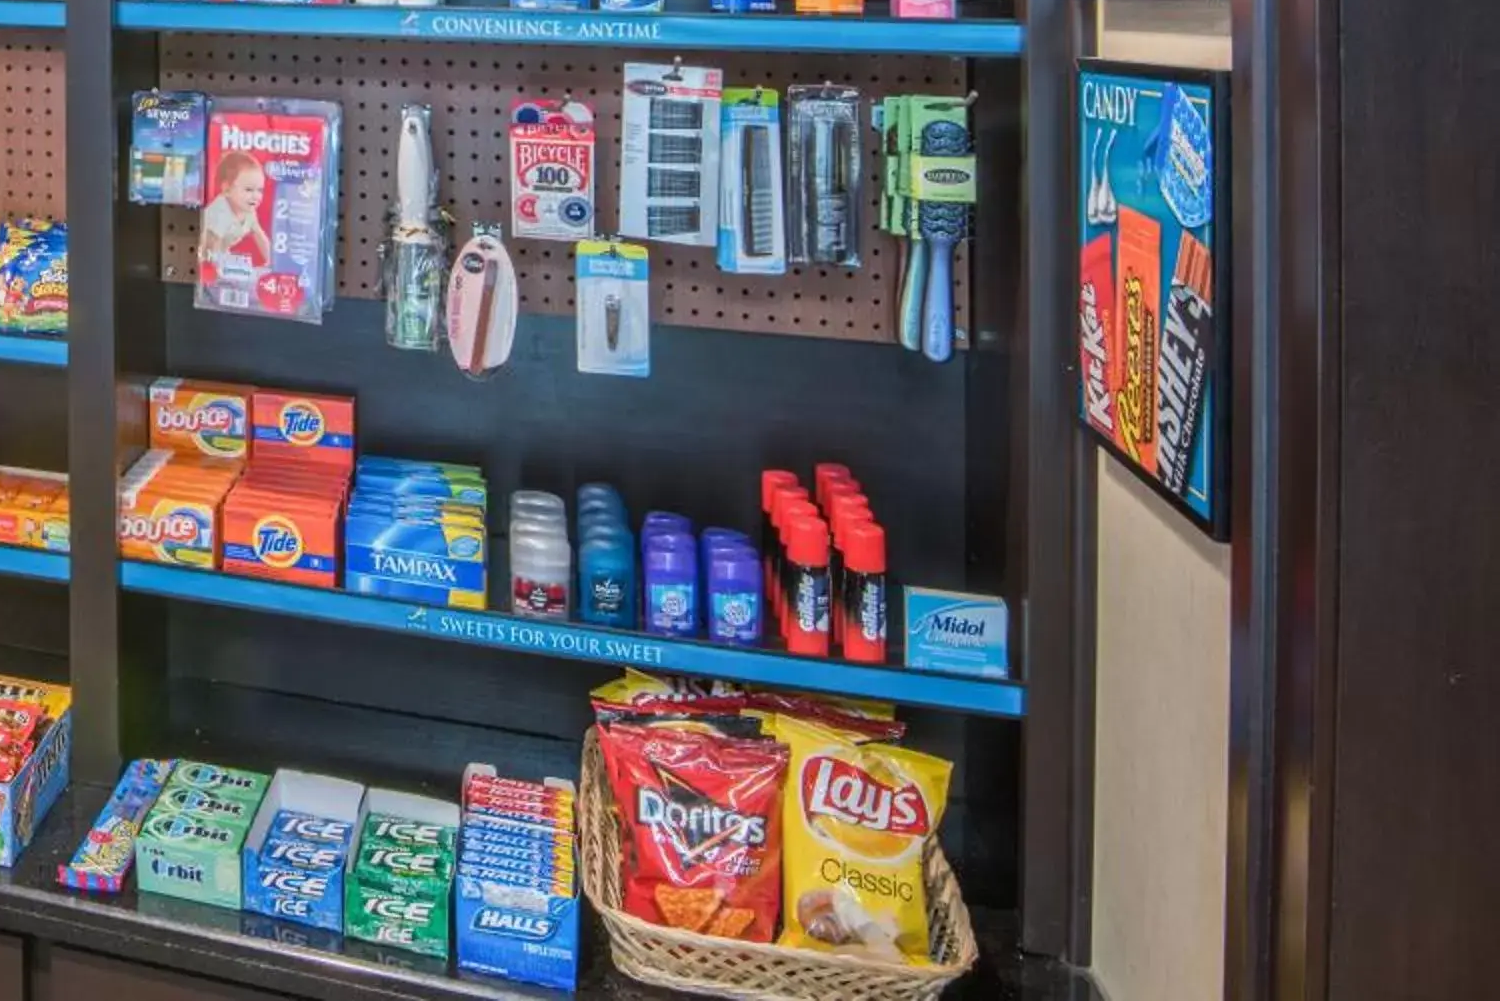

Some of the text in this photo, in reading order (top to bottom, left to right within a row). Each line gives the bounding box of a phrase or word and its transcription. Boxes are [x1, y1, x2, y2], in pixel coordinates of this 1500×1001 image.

[432, 16, 562, 36] CONVENIENCE
[579, 20, 662, 40] ANYTIME
[1083, 80, 1138, 127] CANDY
[221, 125, 312, 155] HUGGIES
[519, 144, 586, 171] BICYCLE
[536, 167, 569, 185] 100
[274, 232, 287, 254] 8
[284, 410, 320, 435] Tide
[258, 528, 298, 554] Tide
[371, 552, 457, 583] TAMPAX
[931, 612, 987, 637] Midol
[440, 614, 665, 665] SWEETS FOR YOUR SWEET
[809, 756, 919, 831] Lay's
[637, 785, 768, 847] Doritos
[282, 818, 349, 841] ICE
[376, 822, 442, 844] ICE
[272, 844, 341, 868] ICE
[370, 849, 440, 873] ICE
[152, 857, 205, 883] Orbit
[820, 856, 915, 903] Classic
[262, 871, 329, 897] ICE
[275, 898, 309, 916] ICE
[363, 898, 436, 923] ICE
[376, 925, 415, 944] ICE
[480, 909, 549, 936] HALLS
